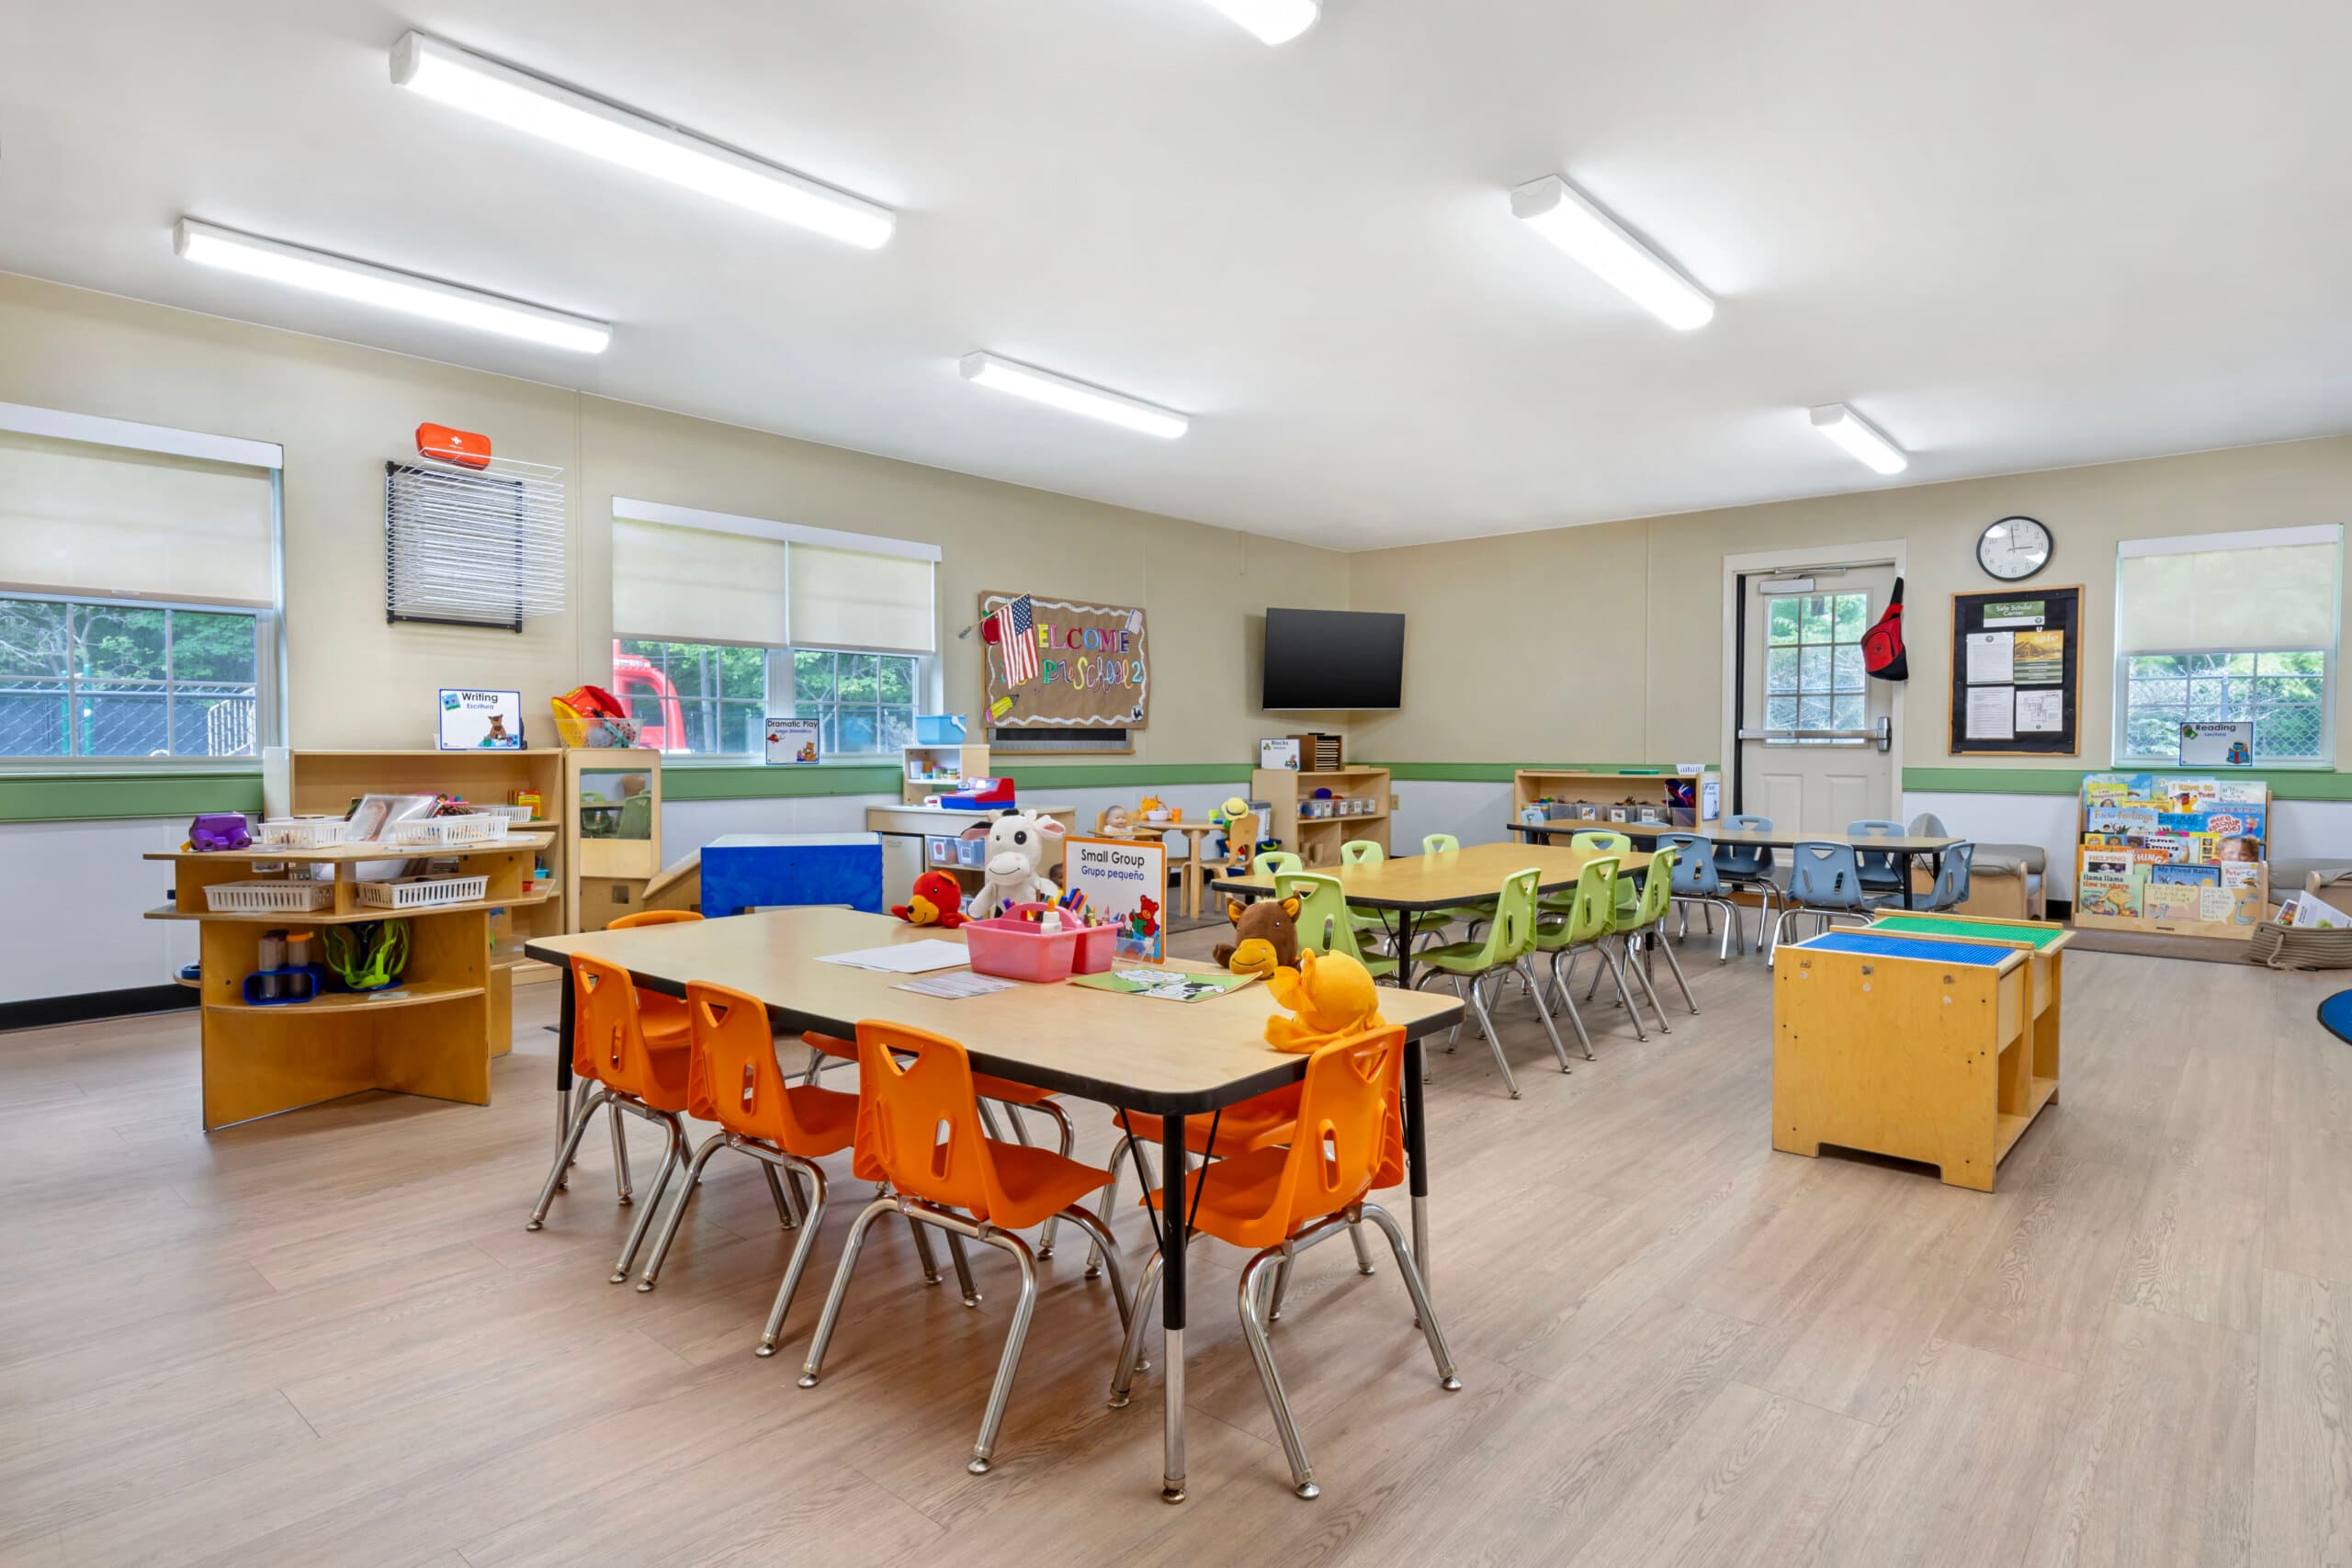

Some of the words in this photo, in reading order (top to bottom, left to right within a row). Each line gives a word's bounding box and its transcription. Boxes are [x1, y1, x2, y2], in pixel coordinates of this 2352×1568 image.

[1036, 624, 1129, 653] ELCOME
[1131, 660, 1143, 683] 2
[461, 692, 498, 704] Writing
[802, 720, 818, 728] Play
[2195, 724, 2236, 732] Reading
[2118, 809, 2154, 823] Feelings
[1080, 849, 1109, 863] Small
[1111, 851, 1145, 869] Group
[1080, 865, 1106, 878] Grupo
[1107, 870, 1145, 881] pequeño
